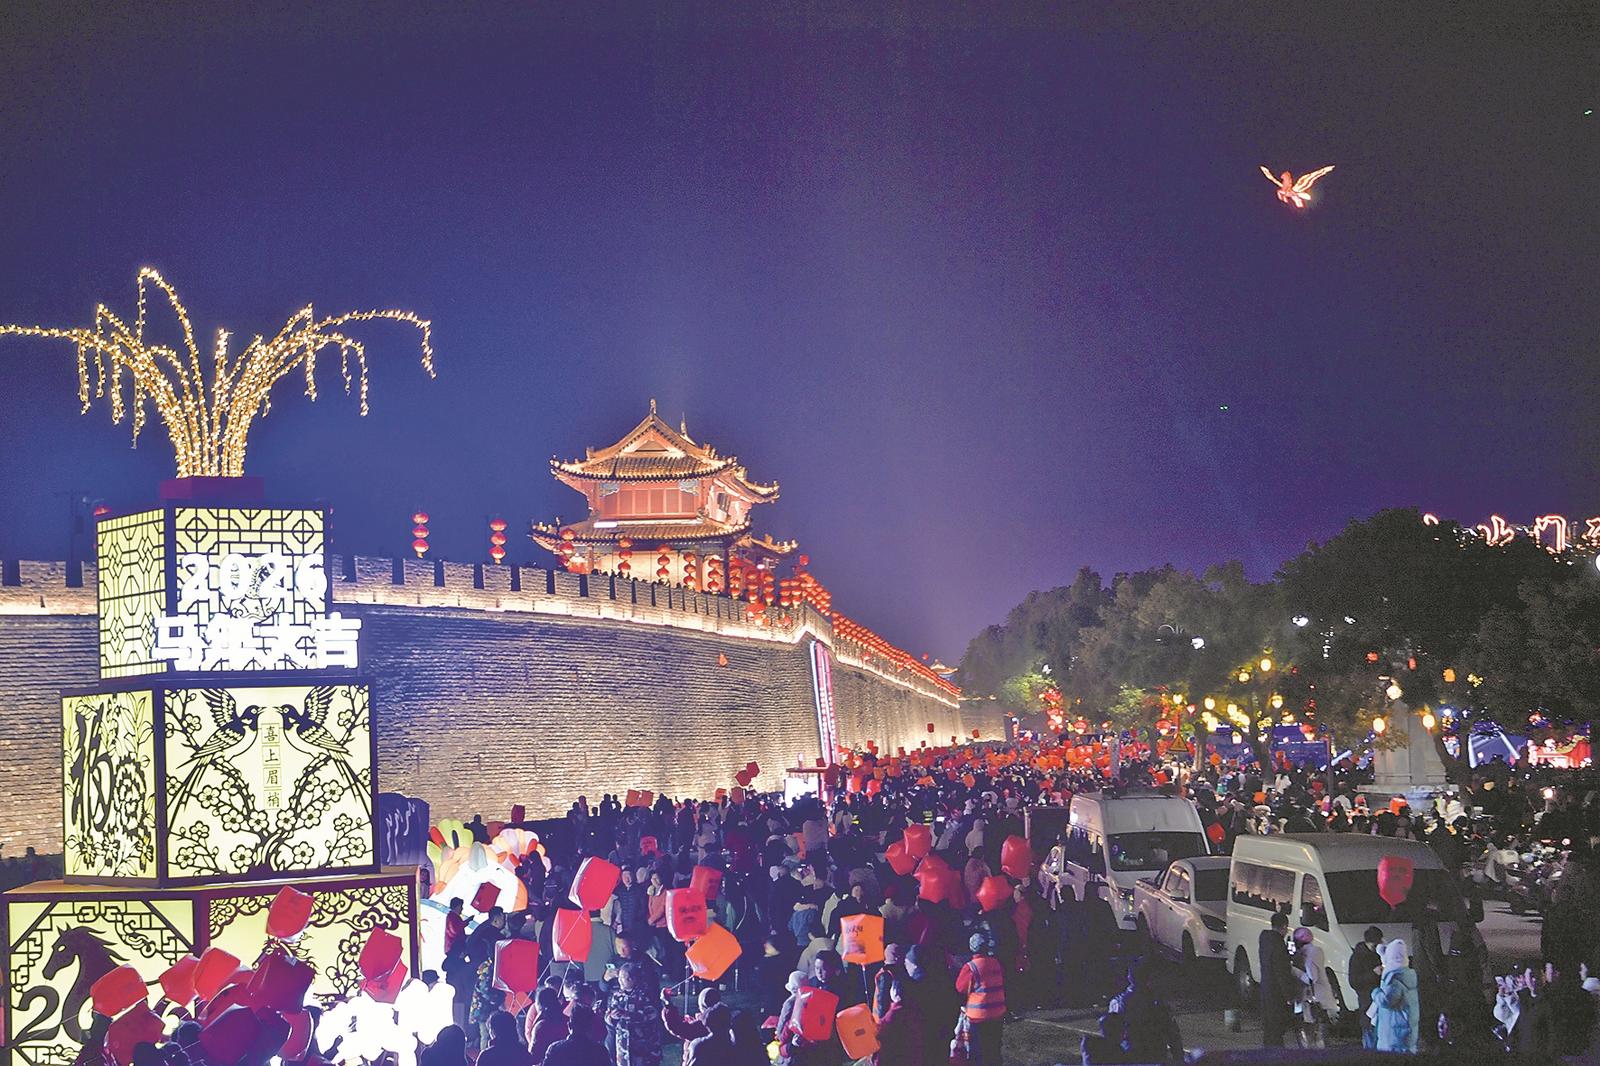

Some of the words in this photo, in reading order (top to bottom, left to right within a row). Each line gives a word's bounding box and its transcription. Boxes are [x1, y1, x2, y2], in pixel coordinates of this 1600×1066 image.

[180, 553, 328, 602] 2026
[150, 611, 362, 671] 马年大吉
[263, 725, 281, 808] 喜上眉梢
